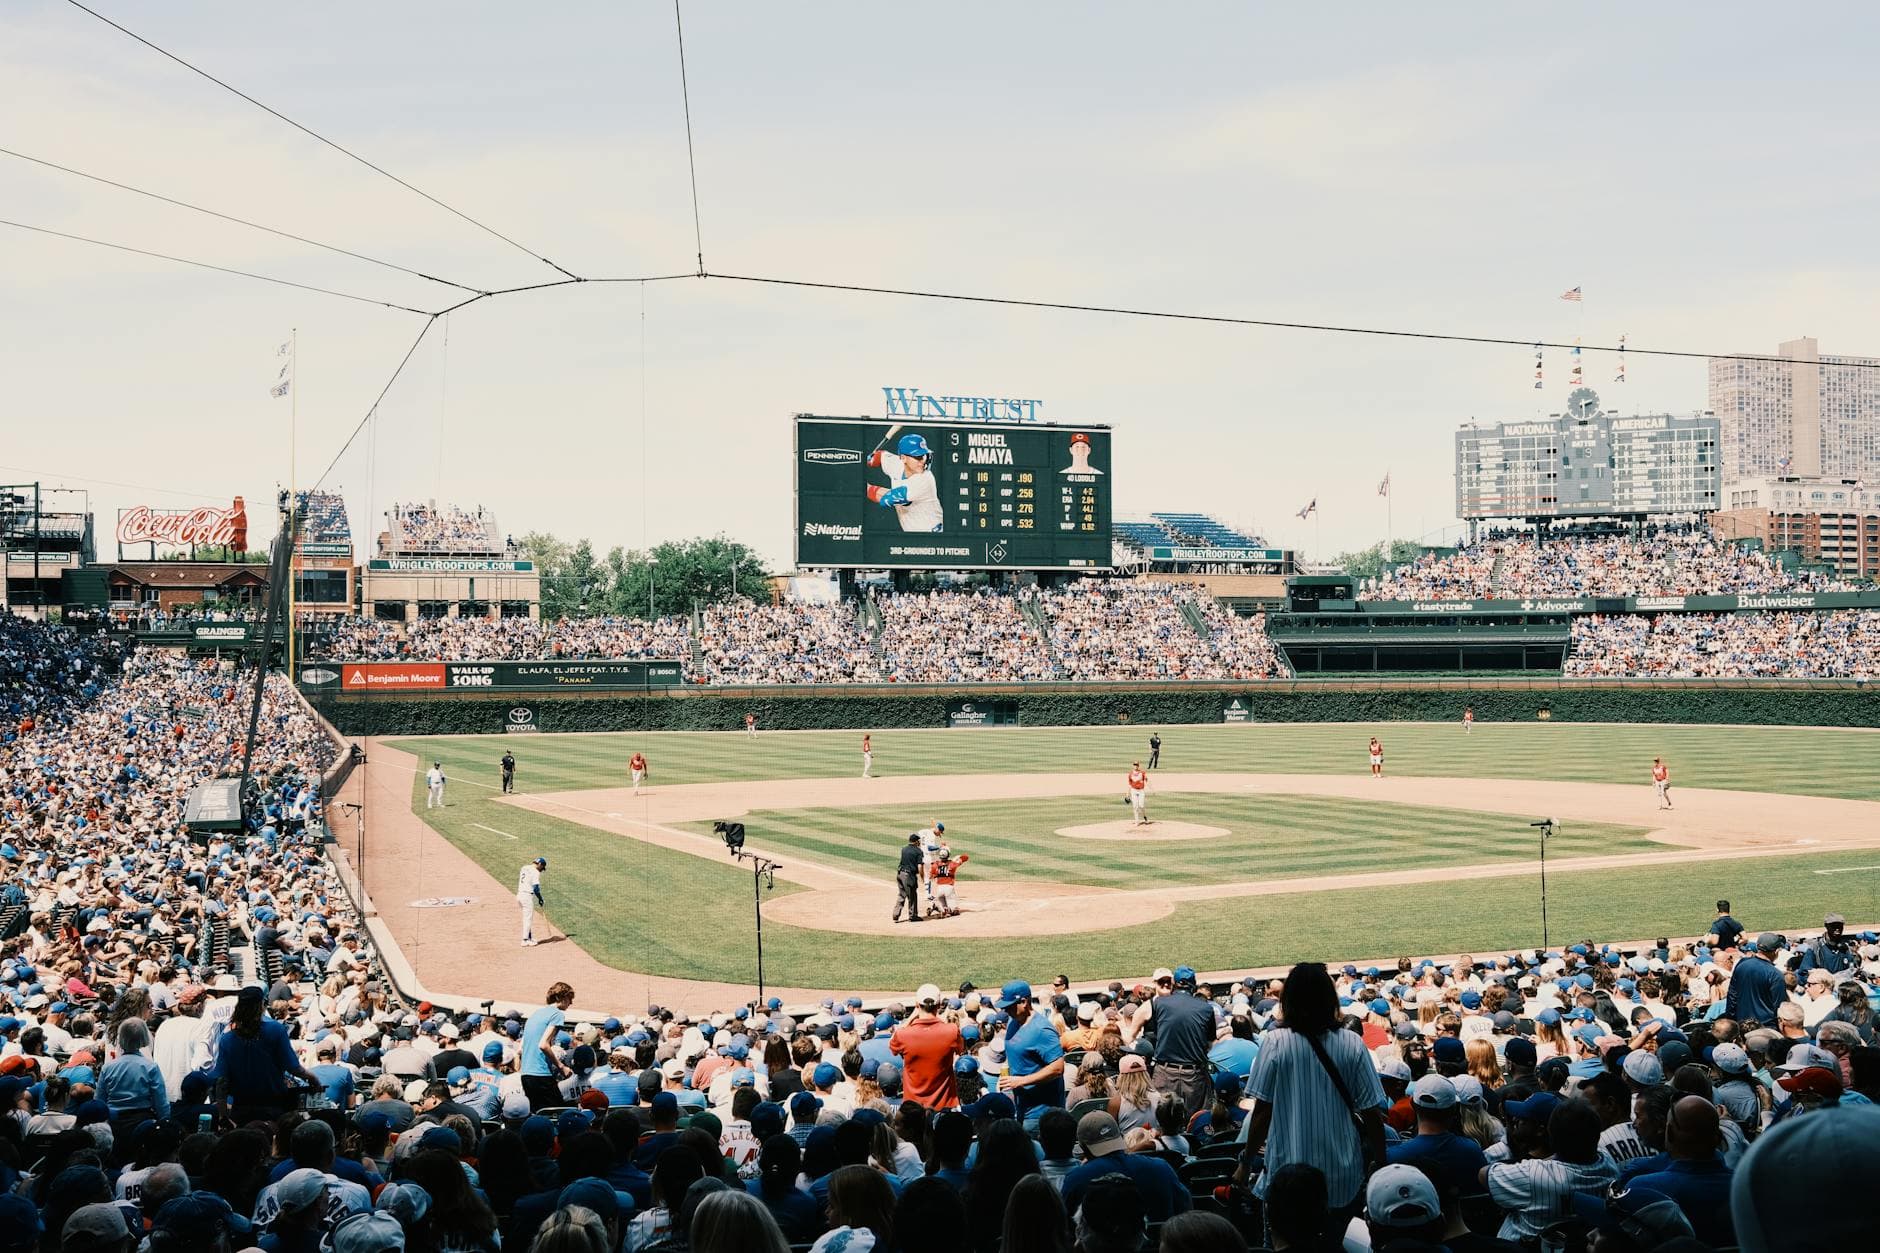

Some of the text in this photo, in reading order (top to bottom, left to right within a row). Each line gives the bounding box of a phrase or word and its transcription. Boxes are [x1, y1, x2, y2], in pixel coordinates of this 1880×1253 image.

[882, 387, 1043, 421] WINTRUST
[1504, 423, 1557, 436] NATIONAL
[1612, 418, 1666, 430] AMERICAN
[968, 433, 1007, 447] MIGUEL
[807, 451, 859, 461] PENNINGTON
[952, 452, 959, 463] C
[968, 447, 1014, 465] AMAYA
[980, 487, 986, 497] 2
[979, 502, 987, 513] 13
[117, 506, 243, 546] Coca-Cola
[817, 523, 863, 535] National
[1017, 518, 1034, 529] .532
[937, 547, 945, 556] TO
[945, 548, 970, 556] PITCHER
[1171, 548, 1267, 559] WRIGLEYROOFTOPS.COM
[388, 561, 515, 571] WRIGLEYROOFTOPS.COM
[1420, 602, 1473, 612] tastytrade
[1535, 601, 1585, 611] Advocate
[1635, 597, 1687, 606] GRAINGER
[1737, 595, 1816, 608] Budweiser
[195, 627, 246, 636] GRAINGER
[451, 666, 495, 674] WALK-UP
[564, 666, 585, 674] JEFE
[367, 674, 440, 685] Benjamin Moore
[452, 674, 493, 686] SONG
[555, 675, 594, 684] "PANAMA"
[950, 711, 987, 719] Gallagher
[731, 1131, 743, 1141] LA
